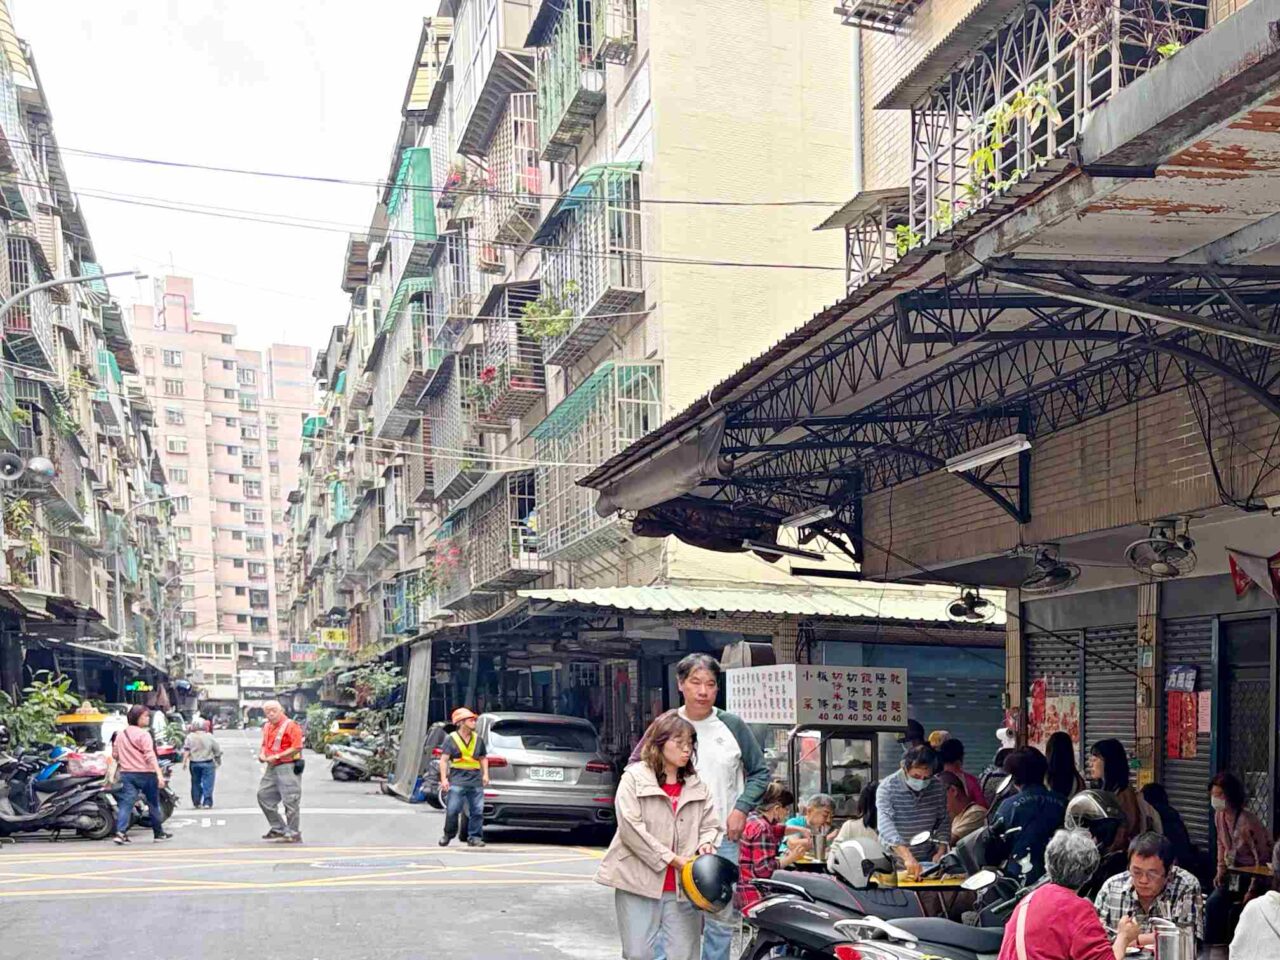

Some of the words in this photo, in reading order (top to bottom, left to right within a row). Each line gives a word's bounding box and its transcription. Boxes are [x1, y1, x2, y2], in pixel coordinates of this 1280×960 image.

[832, 713, 844, 721] 40
[847, 713, 858, 721] 40
[891, 714, 901, 722] 40
